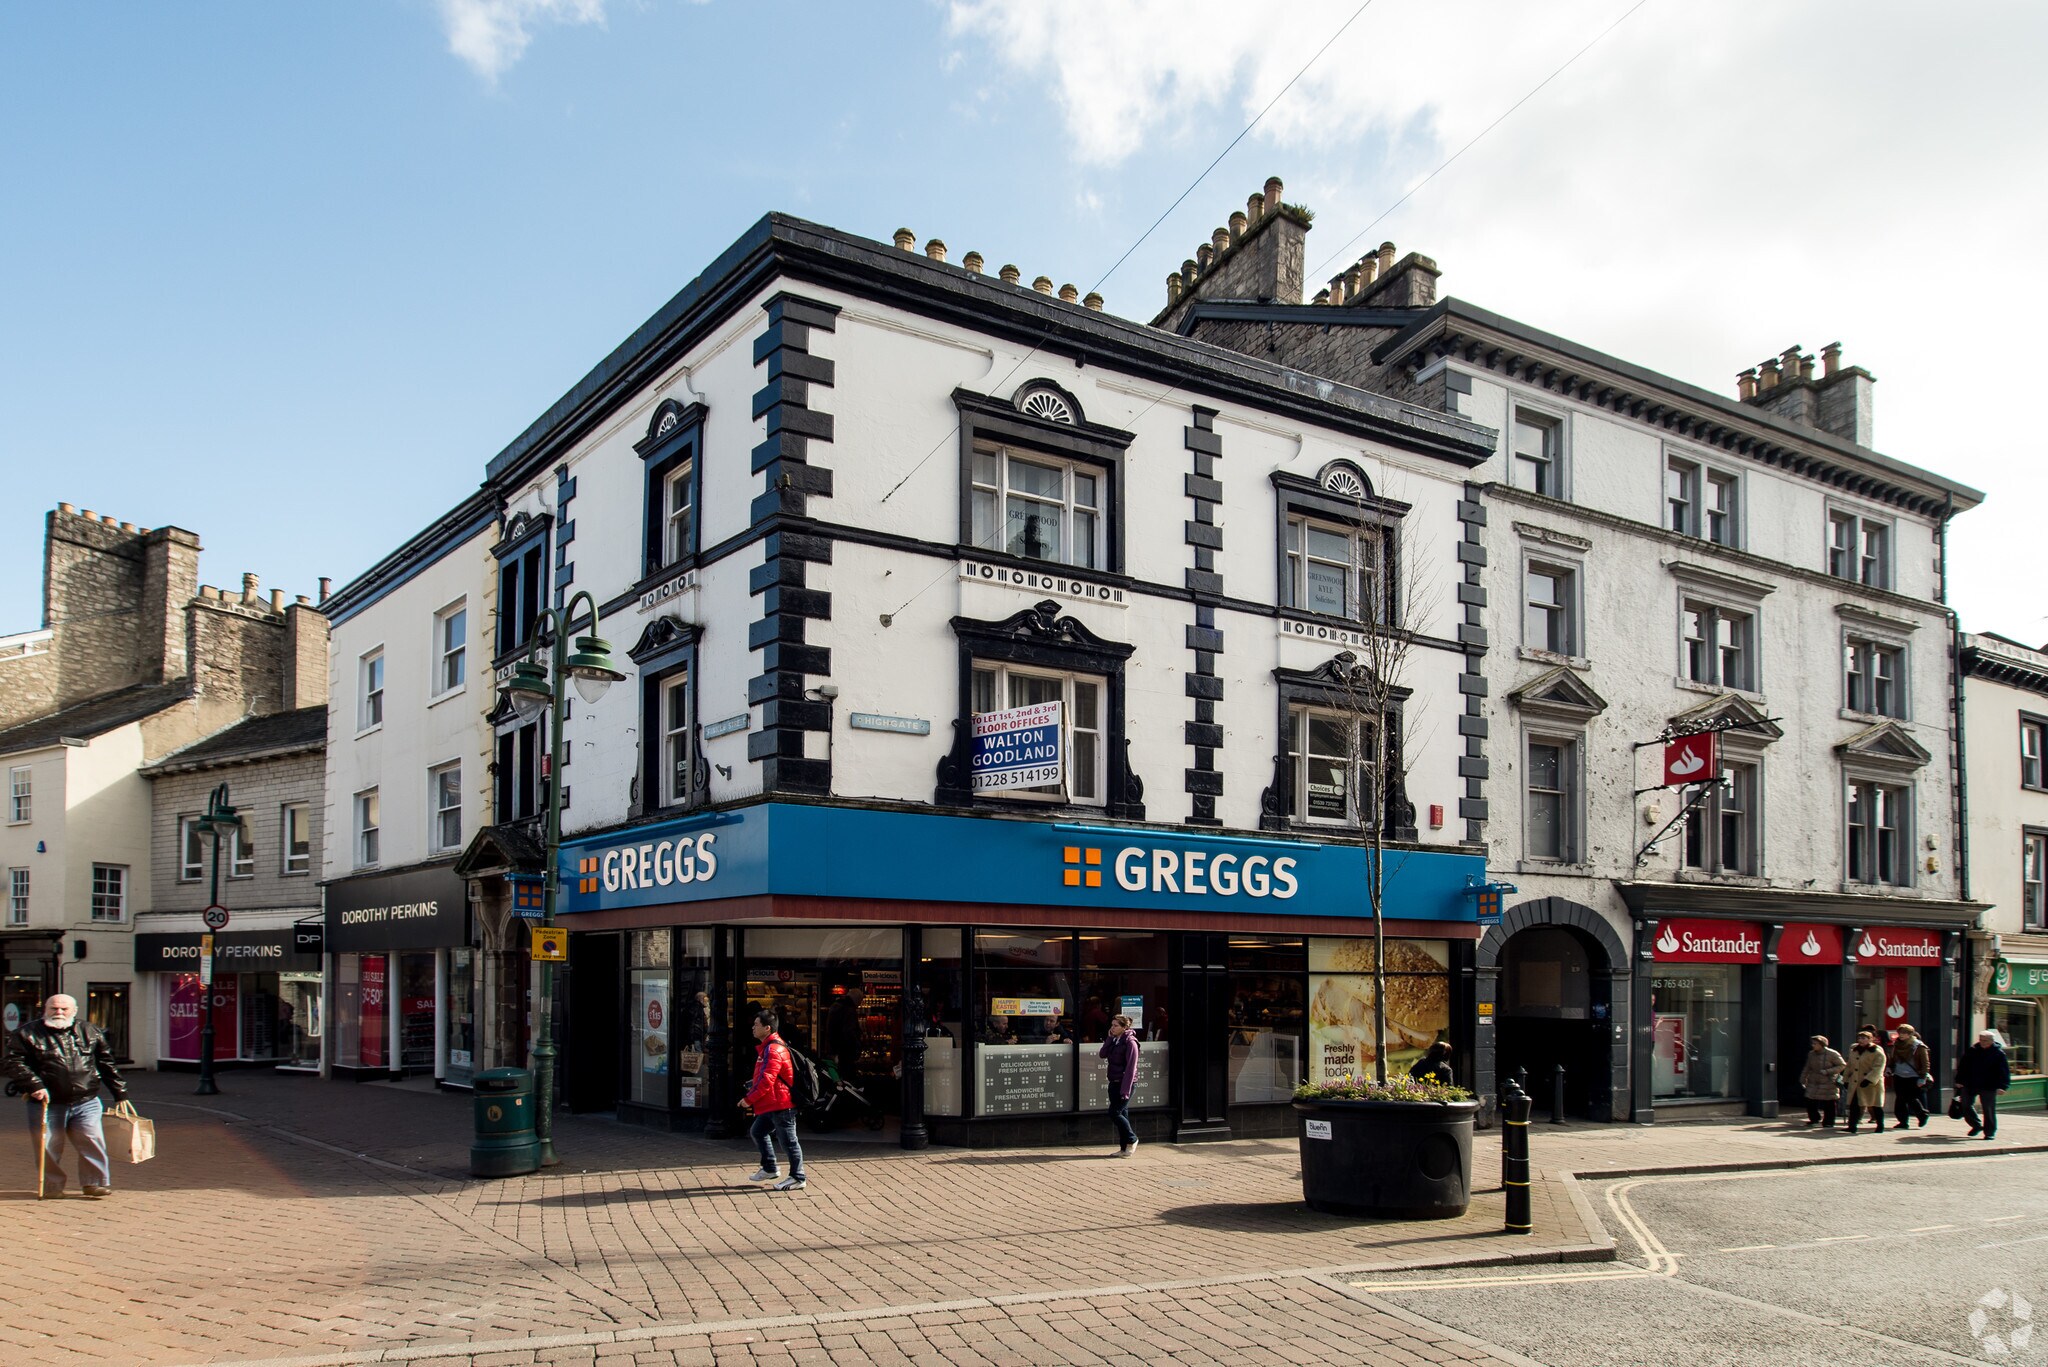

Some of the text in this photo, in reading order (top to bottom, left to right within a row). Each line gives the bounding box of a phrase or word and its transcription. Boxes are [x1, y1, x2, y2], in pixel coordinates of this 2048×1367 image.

[1009, 510, 1058, 527] GREOOD
[1318, 584, 1334, 594] KYLE
[972, 717, 982, 725] TO
[984, 714, 997, 722] LET
[1000, 712, 1014, 720] 1st,
[1016, 708, 1032, 718] 2nd
[1042, 704, 1057, 712] 3rd
[864, 716, 918, 730] HIGHGATE
[976, 714, 1050, 734] FLOOR OFFICES
[984, 730, 1044, 750] WALTON
[972, 744, 1056, 766] GOODLAND
[972, 766, 1058, 788] 01228 514199
[1310, 784, 1330, 792] Choices
[603, 832, 718, 892] GREGGS
[1115, 847, 1298, 899] GREGGS
[208, 912, 226, 922] 20
[342, 901, 438, 924] DOROTHY PERKINS
[297, 934, 321, 944] DP
[1682, 932, 1760, 954] Santander
[162, 945, 282, 958] DOROTY PERKINS
[1878, 938, 1940, 958] Santander
[1664, 980, 1676, 988] 765
[1678, 980, 1694, 988] 4321
[170, 1003, 198, 1018] SALE
[416, 1000, 435, 1010] SAL
[1324, 1044, 1355, 1054] Freshly
[1324, 1054, 1355, 1064] made
[1324, 1065, 1354, 1078] today
[1309, 1122, 1328, 1132] Bluefin
